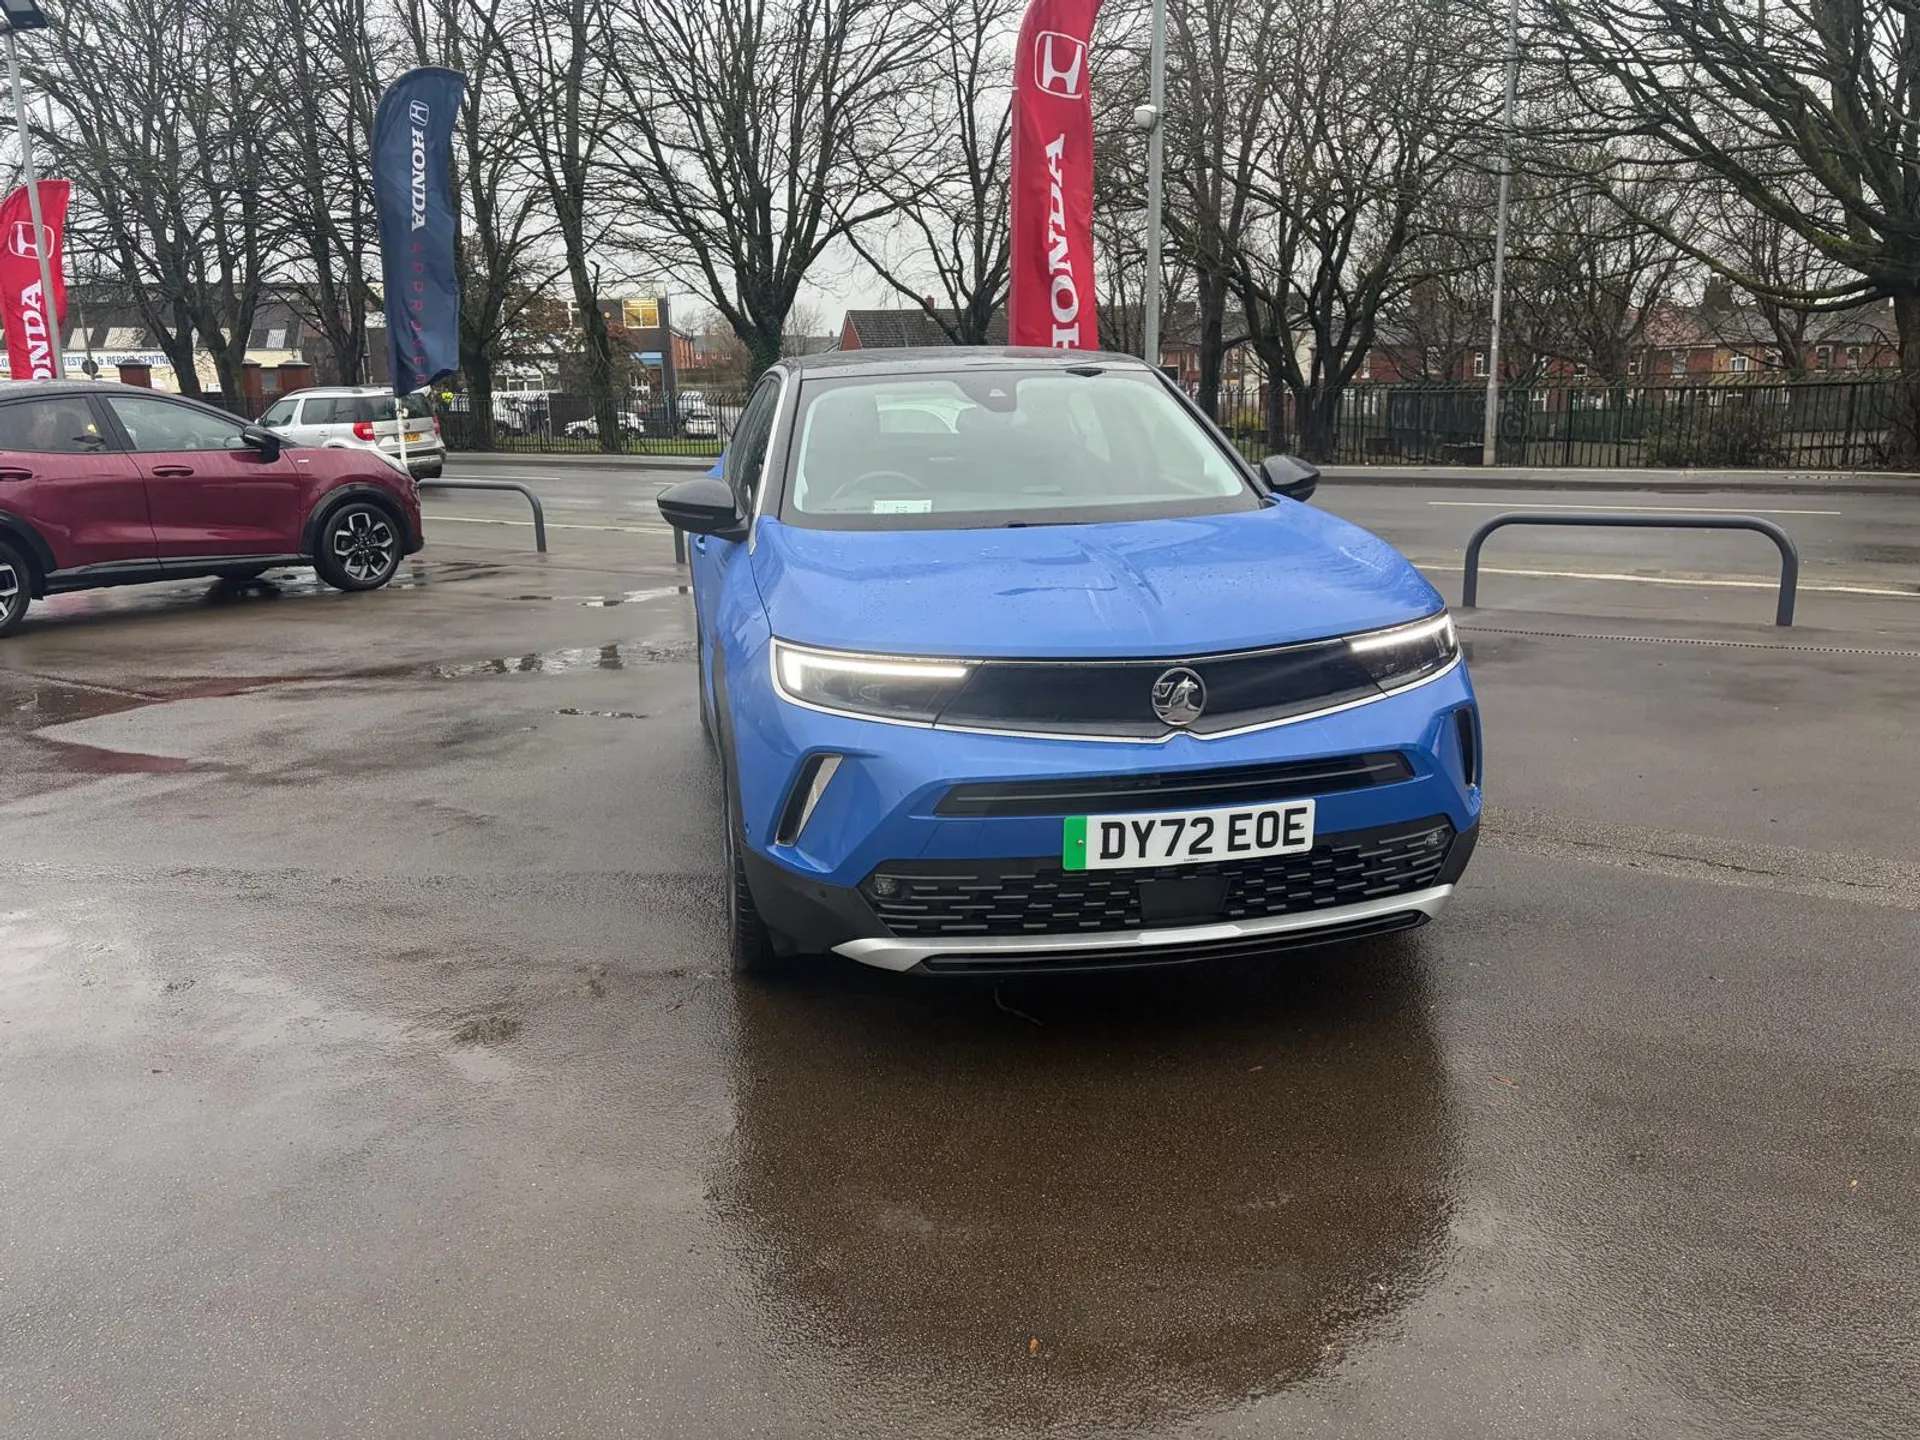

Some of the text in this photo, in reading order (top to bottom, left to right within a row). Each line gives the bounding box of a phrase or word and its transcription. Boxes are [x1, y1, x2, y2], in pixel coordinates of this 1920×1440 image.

[411, 126, 426, 231] HONDA
[21, 279, 53, 380] NDA
[1100, 807, 1308, 860] DY72 EOE
